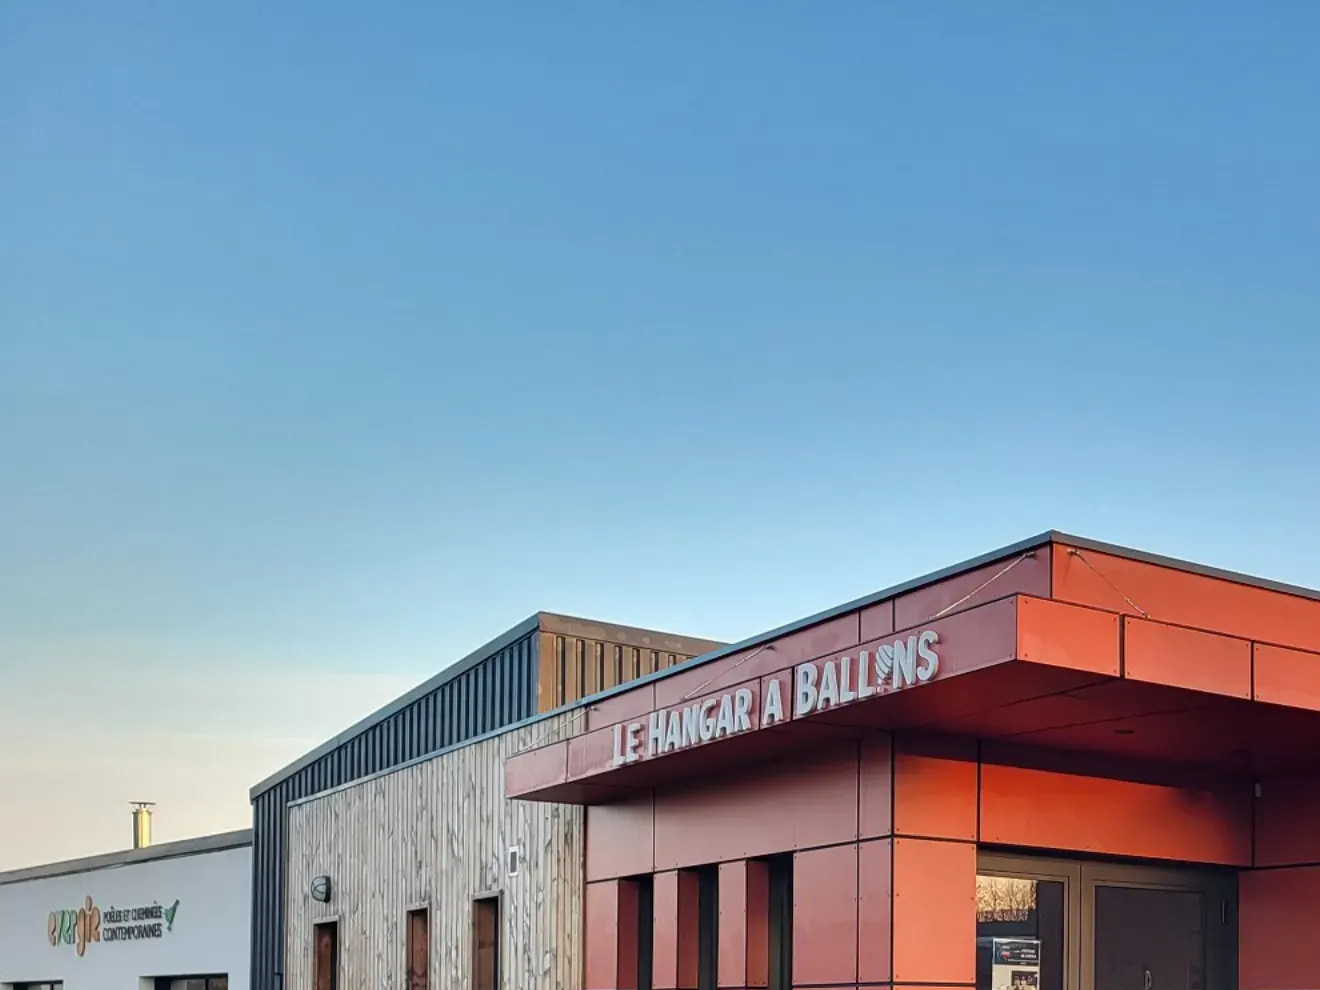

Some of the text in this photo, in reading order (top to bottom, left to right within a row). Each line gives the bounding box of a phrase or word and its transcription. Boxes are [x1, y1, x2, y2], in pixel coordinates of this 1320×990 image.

[612, 723, 641, 767] LE
[648, 688, 753, 757] HANGAR
[762, 679, 784, 725] A
[103, 923, 162, 941] CONTEMPORAINES
